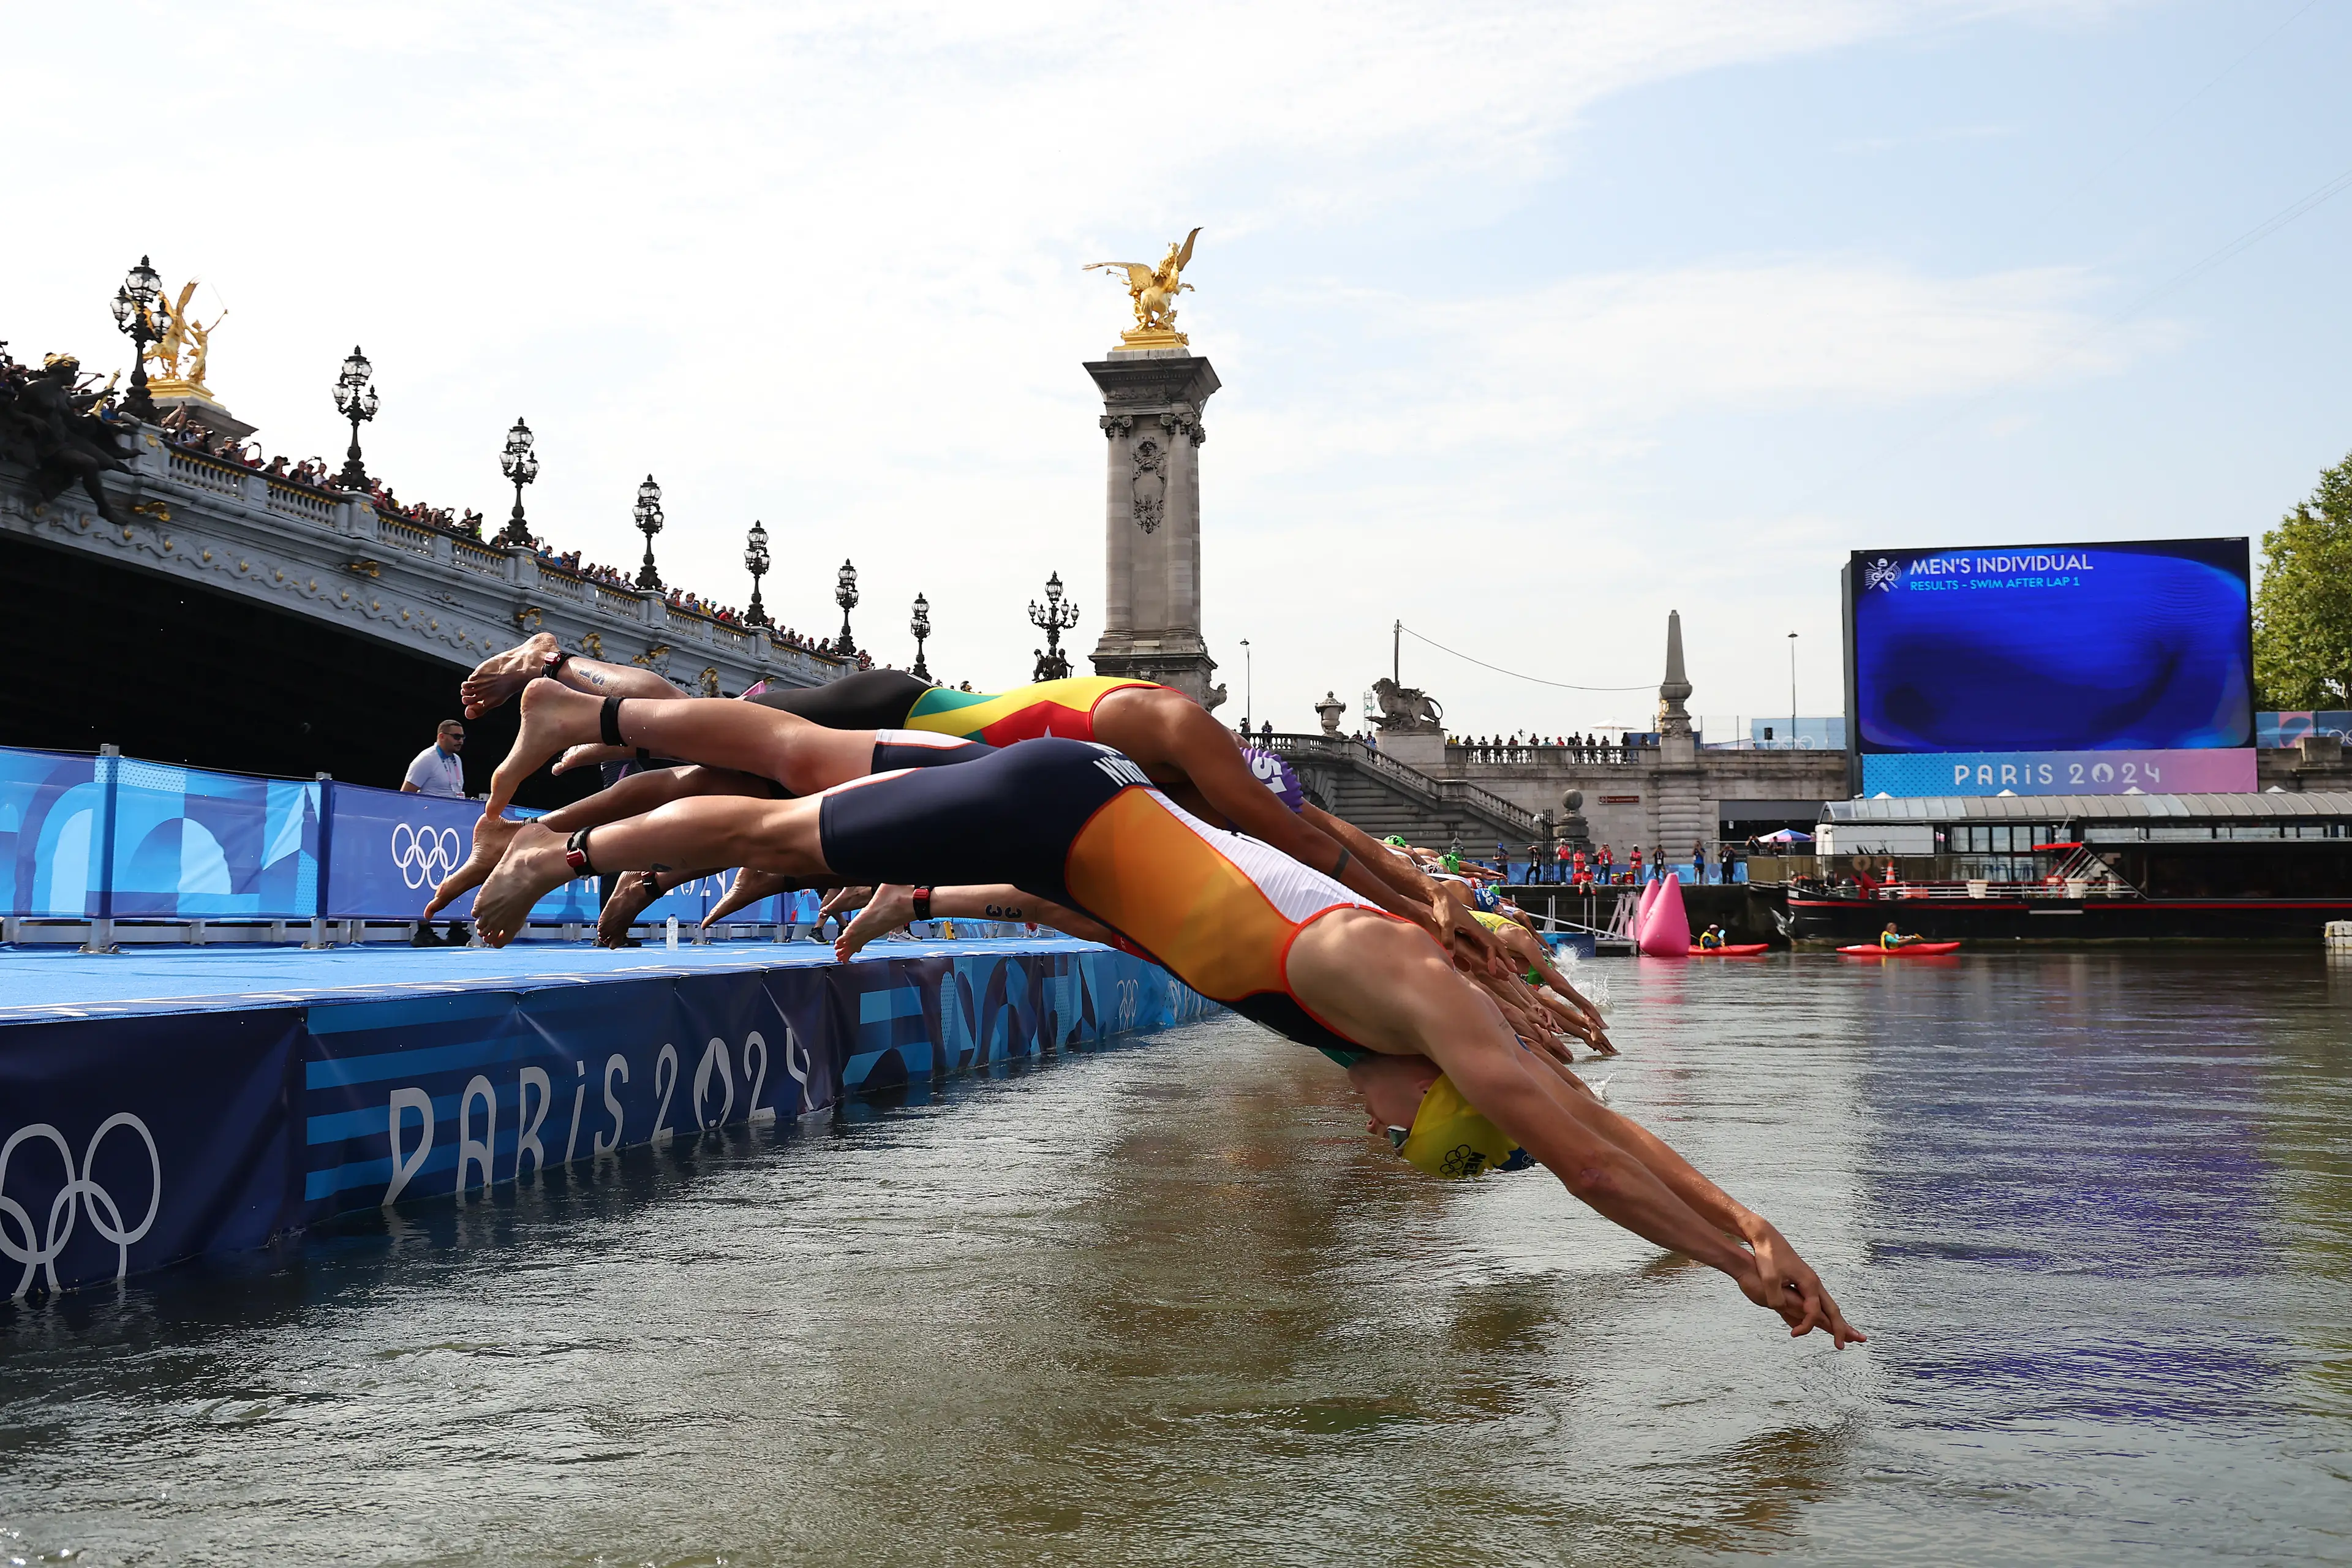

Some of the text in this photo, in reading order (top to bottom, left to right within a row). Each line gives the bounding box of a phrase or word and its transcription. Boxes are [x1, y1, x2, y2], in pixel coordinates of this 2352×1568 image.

[1910, 554, 2094, 576] MEN'S INDIVIDUAL
[1910, 580, 1959, 591] RESULTS
[1970, 579, 2003, 589] SWIM
[2006, 578, 2044, 589] AFTER
[2046, 576, 2070, 587] LAP
[2073, 576, 2080, 586] 1
[1251, 756, 1287, 794] 51
[2069, 763, 2160, 784] 2024
[1482, 890, 1494, 905] 38
[650, 1027, 815, 1142] 2024
